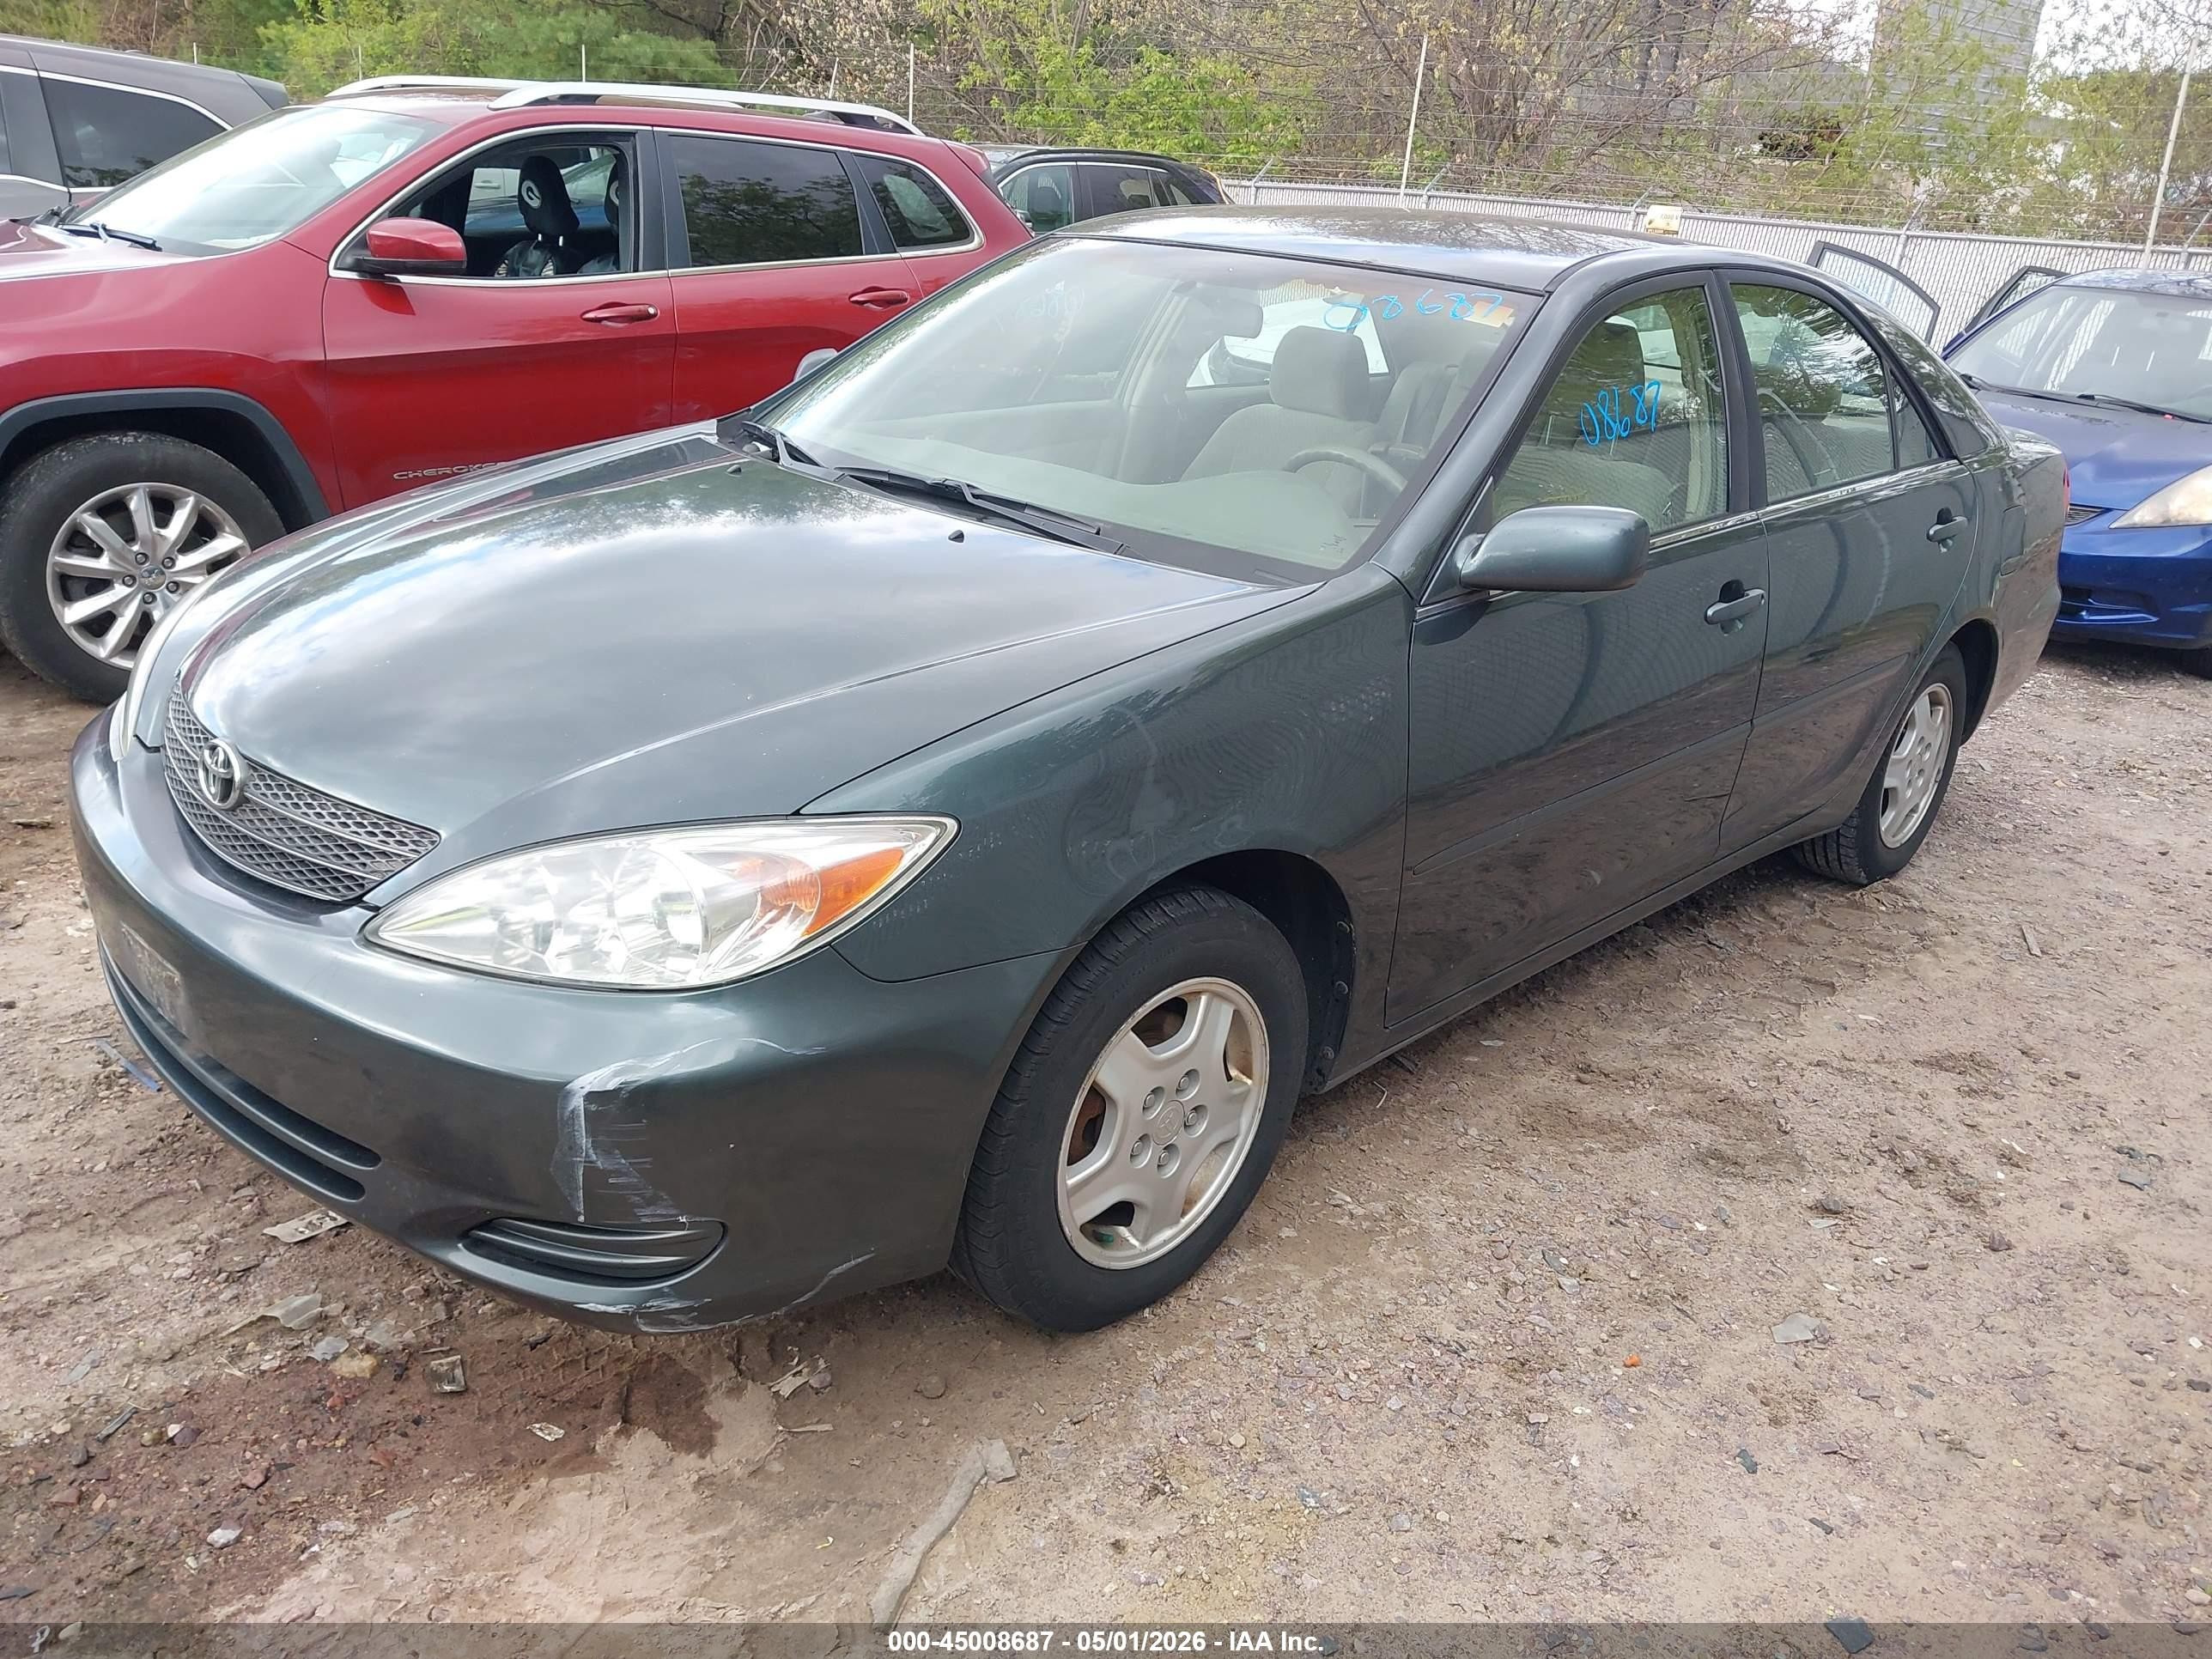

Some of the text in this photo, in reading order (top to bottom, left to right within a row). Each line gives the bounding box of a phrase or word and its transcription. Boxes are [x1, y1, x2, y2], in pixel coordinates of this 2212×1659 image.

[1323, 289, 1503, 331] 08687
[1580, 379, 1662, 446] 08687
[393, 462, 507, 479] CHEROK
